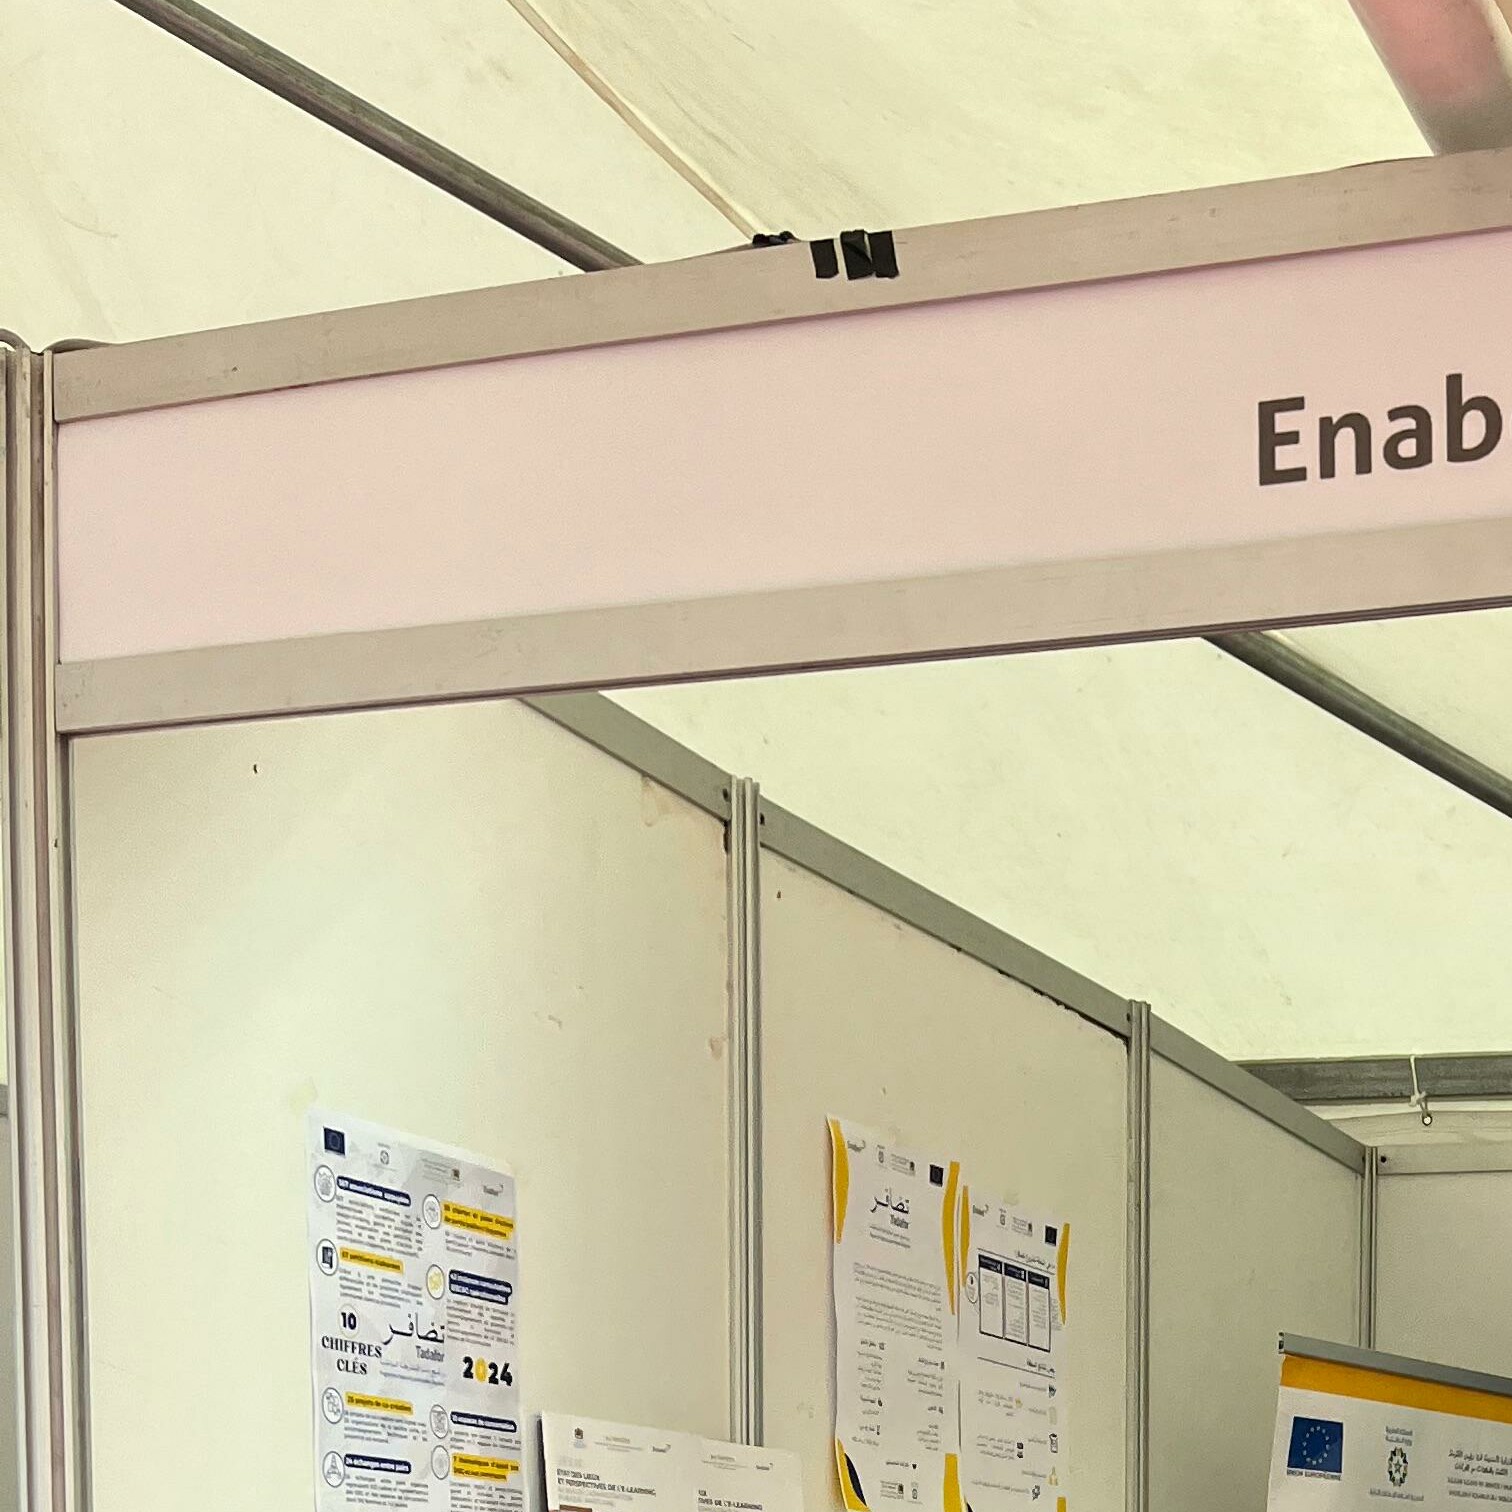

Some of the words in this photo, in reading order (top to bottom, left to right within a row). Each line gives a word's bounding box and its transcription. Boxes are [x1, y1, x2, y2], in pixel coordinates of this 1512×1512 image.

[340, 1312, 357, 1330] 10
[381, 1312, 445, 1345] تضافر
[321, 1335, 382, 1358] CHIFFRES
[336, 1356, 367, 1375] CLÉS
[462, 1356, 513, 1387] 2024
